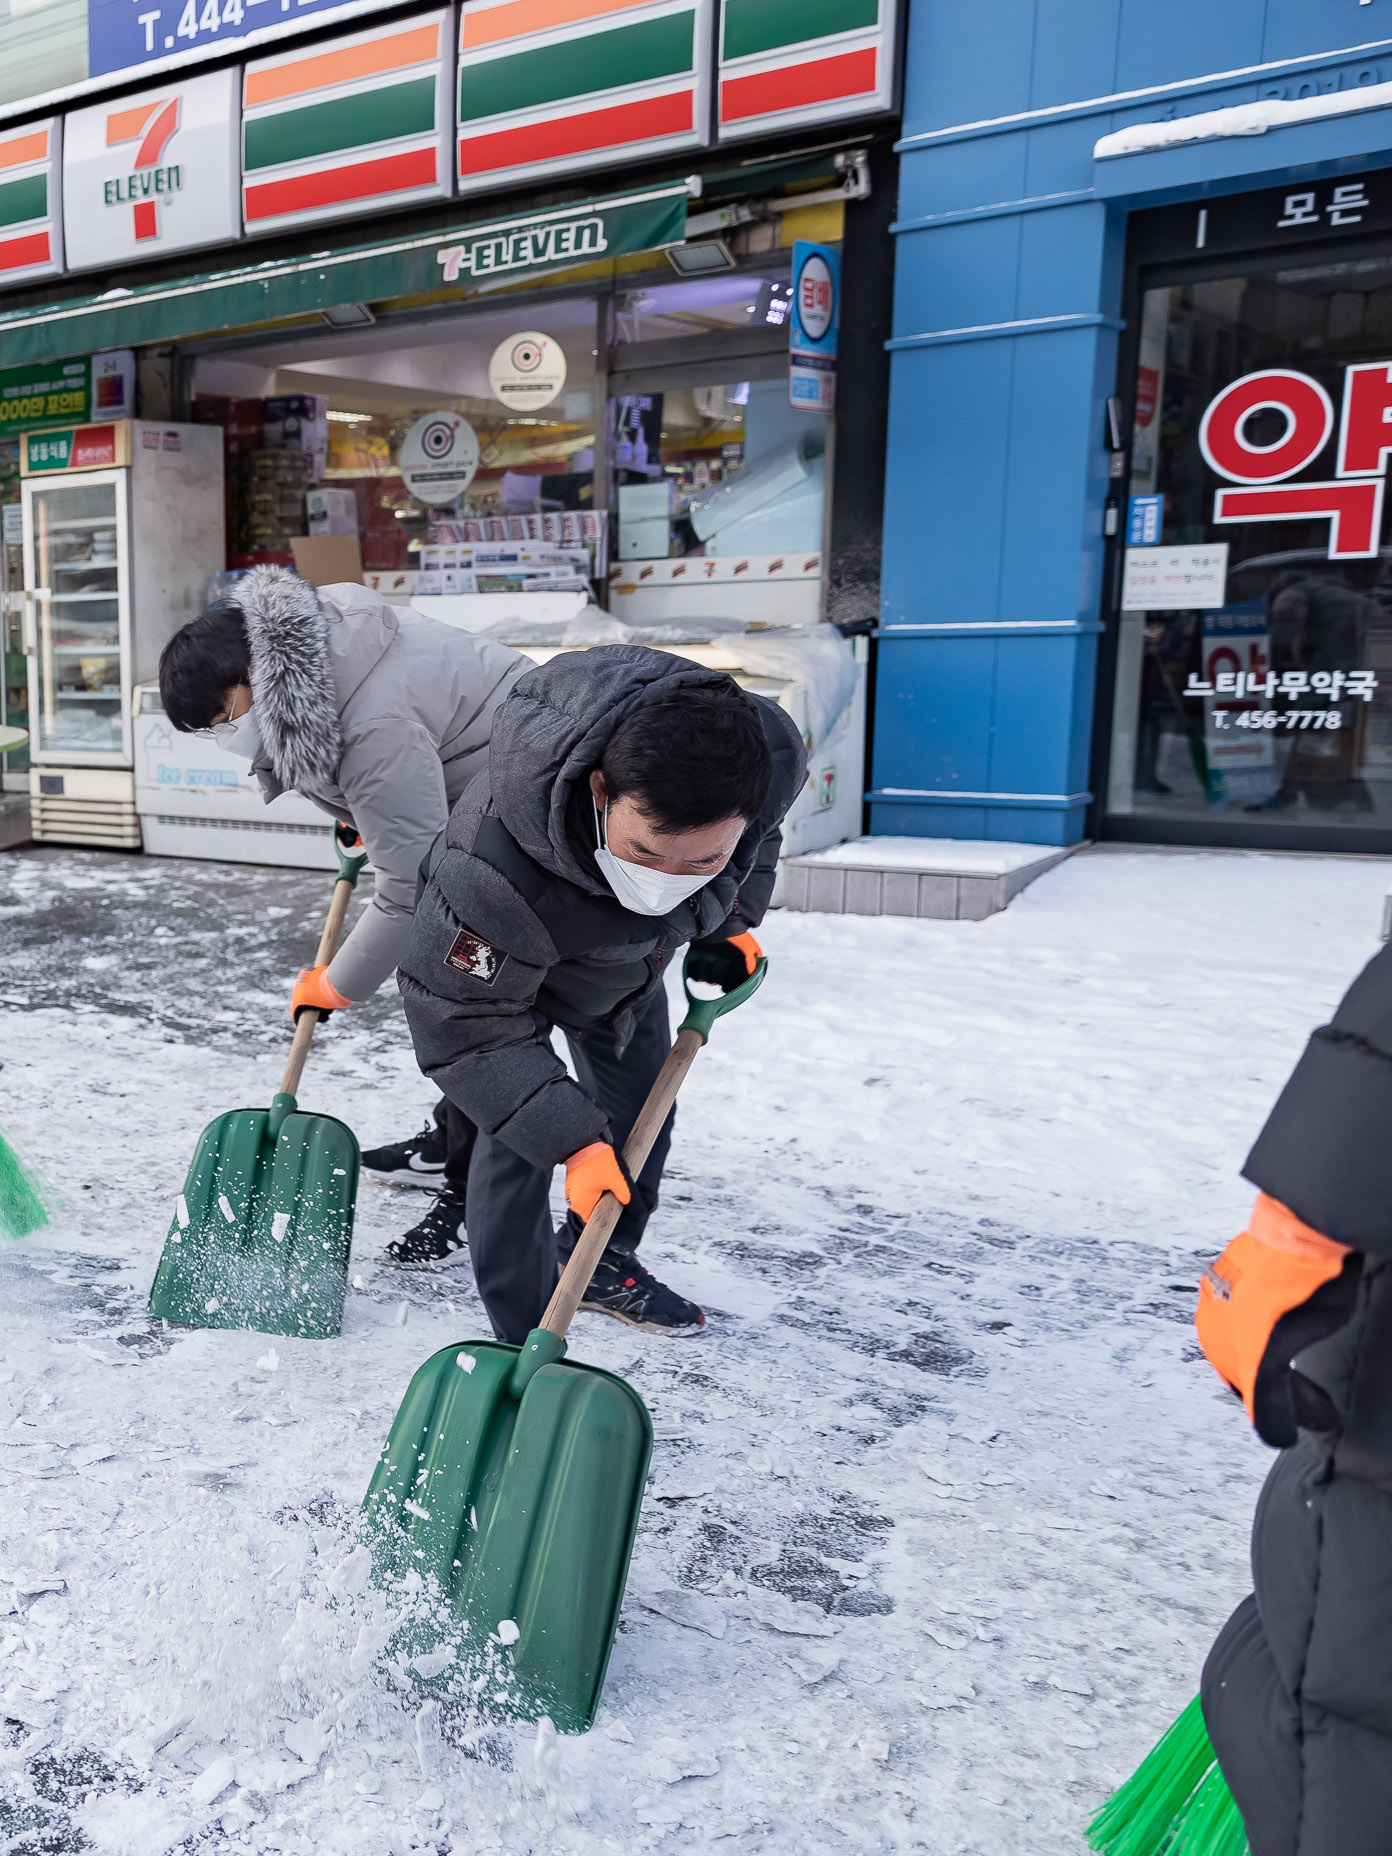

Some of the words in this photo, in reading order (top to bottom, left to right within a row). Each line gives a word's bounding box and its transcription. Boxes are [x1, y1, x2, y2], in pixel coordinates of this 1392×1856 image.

[106, 96, 179, 241] 7
[1276, 182, 1370, 227] 모든
[1182, 670, 1379, 702] 느티나무약국
[1211, 710, 1231, 730] T.
[1234, 710, 1343, 730] 456-7778
